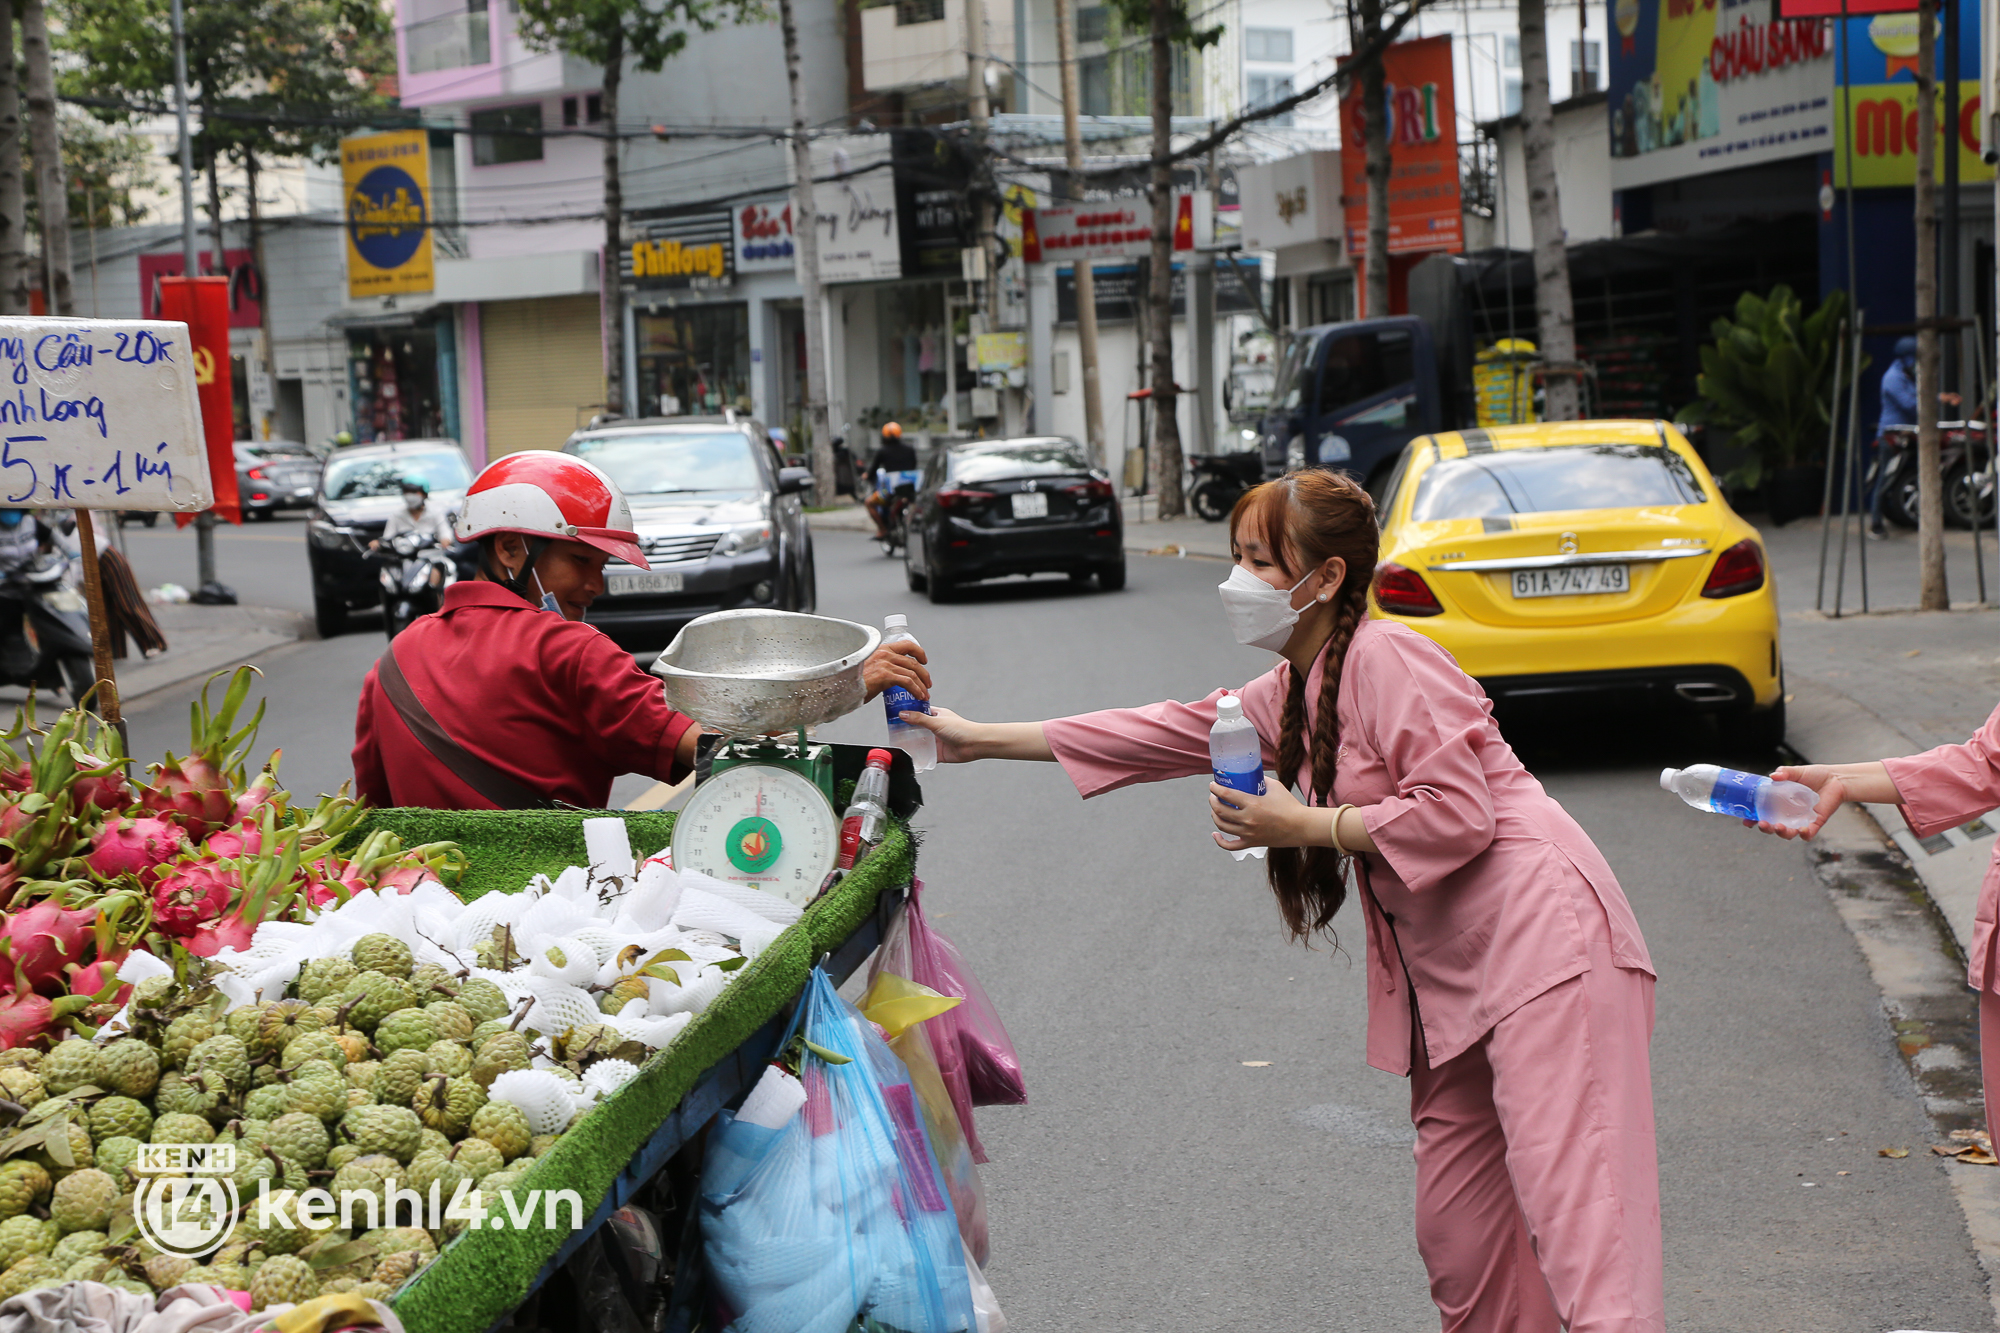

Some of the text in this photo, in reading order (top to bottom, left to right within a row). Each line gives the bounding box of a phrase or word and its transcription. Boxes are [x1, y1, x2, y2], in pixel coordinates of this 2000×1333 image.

[632, 239, 725, 278] ShiHong
[884, 690, 922, 705] AQUAFIN
[795, 868, 802, 880] 5
